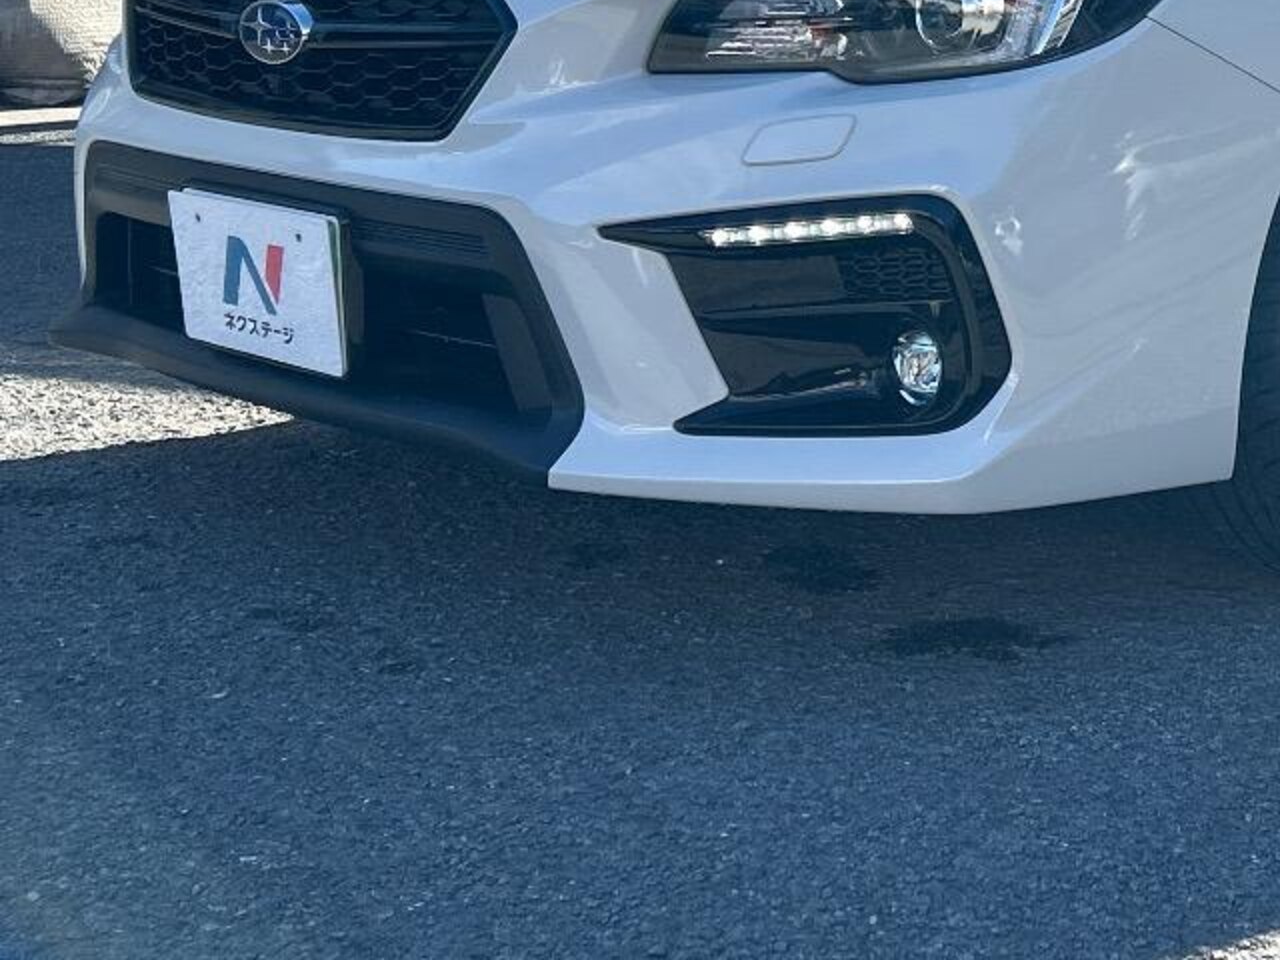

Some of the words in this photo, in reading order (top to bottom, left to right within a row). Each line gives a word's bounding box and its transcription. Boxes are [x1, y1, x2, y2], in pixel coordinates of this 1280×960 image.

[223, 235, 284, 317] N
[224, 312, 295, 344] ネクステージ
